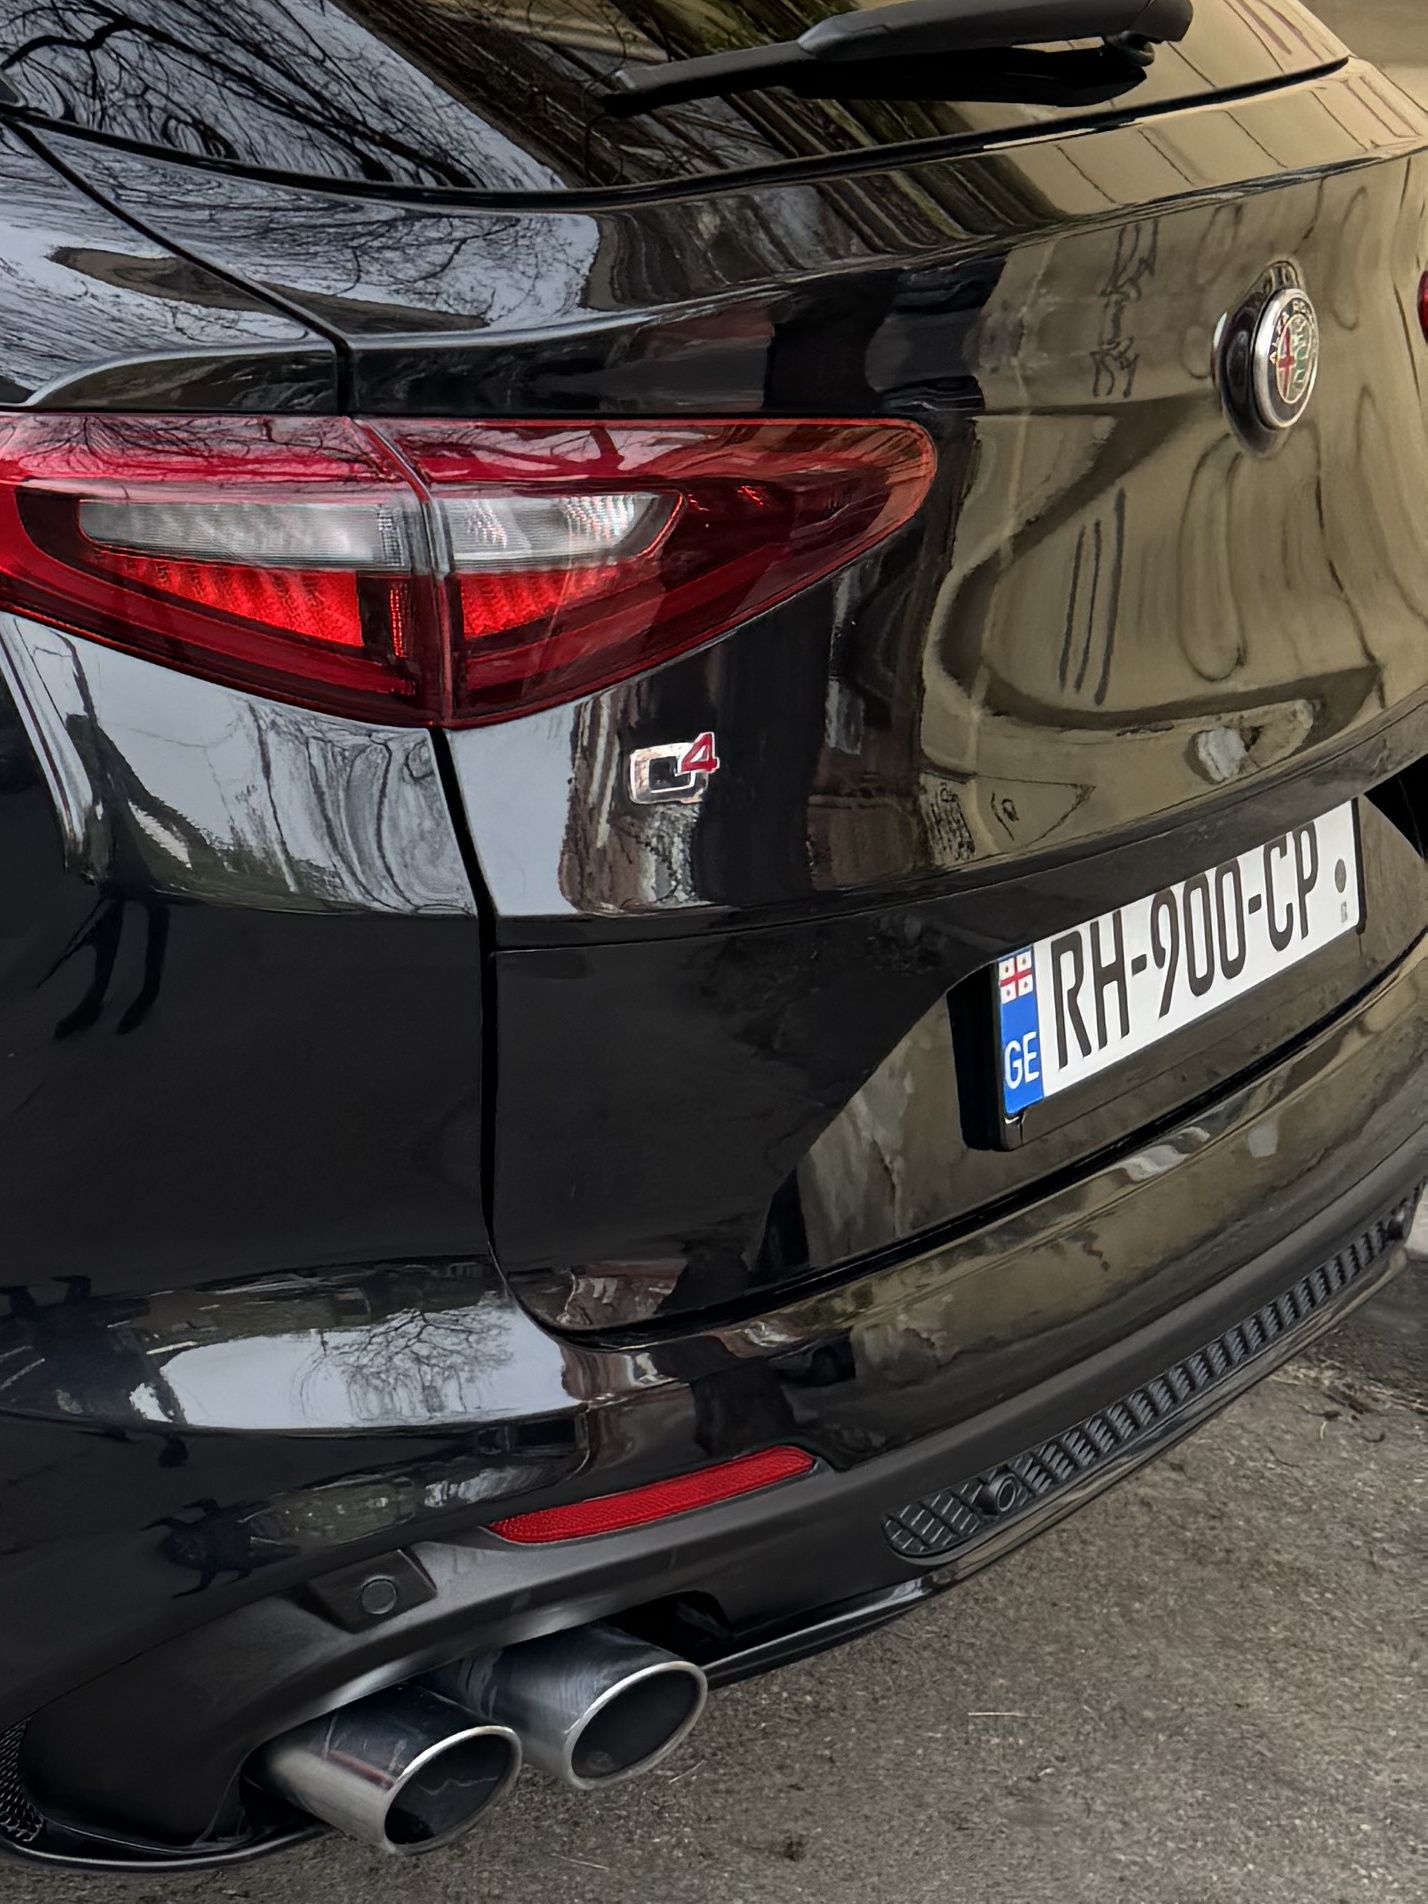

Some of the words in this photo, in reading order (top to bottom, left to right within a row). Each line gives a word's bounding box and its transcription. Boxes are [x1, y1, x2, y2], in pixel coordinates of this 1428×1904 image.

[629, 731, 721, 806] Q4
[1004, 1029, 1040, 1091] GE
[1050, 820, 1320, 1071] RH-900-CP
